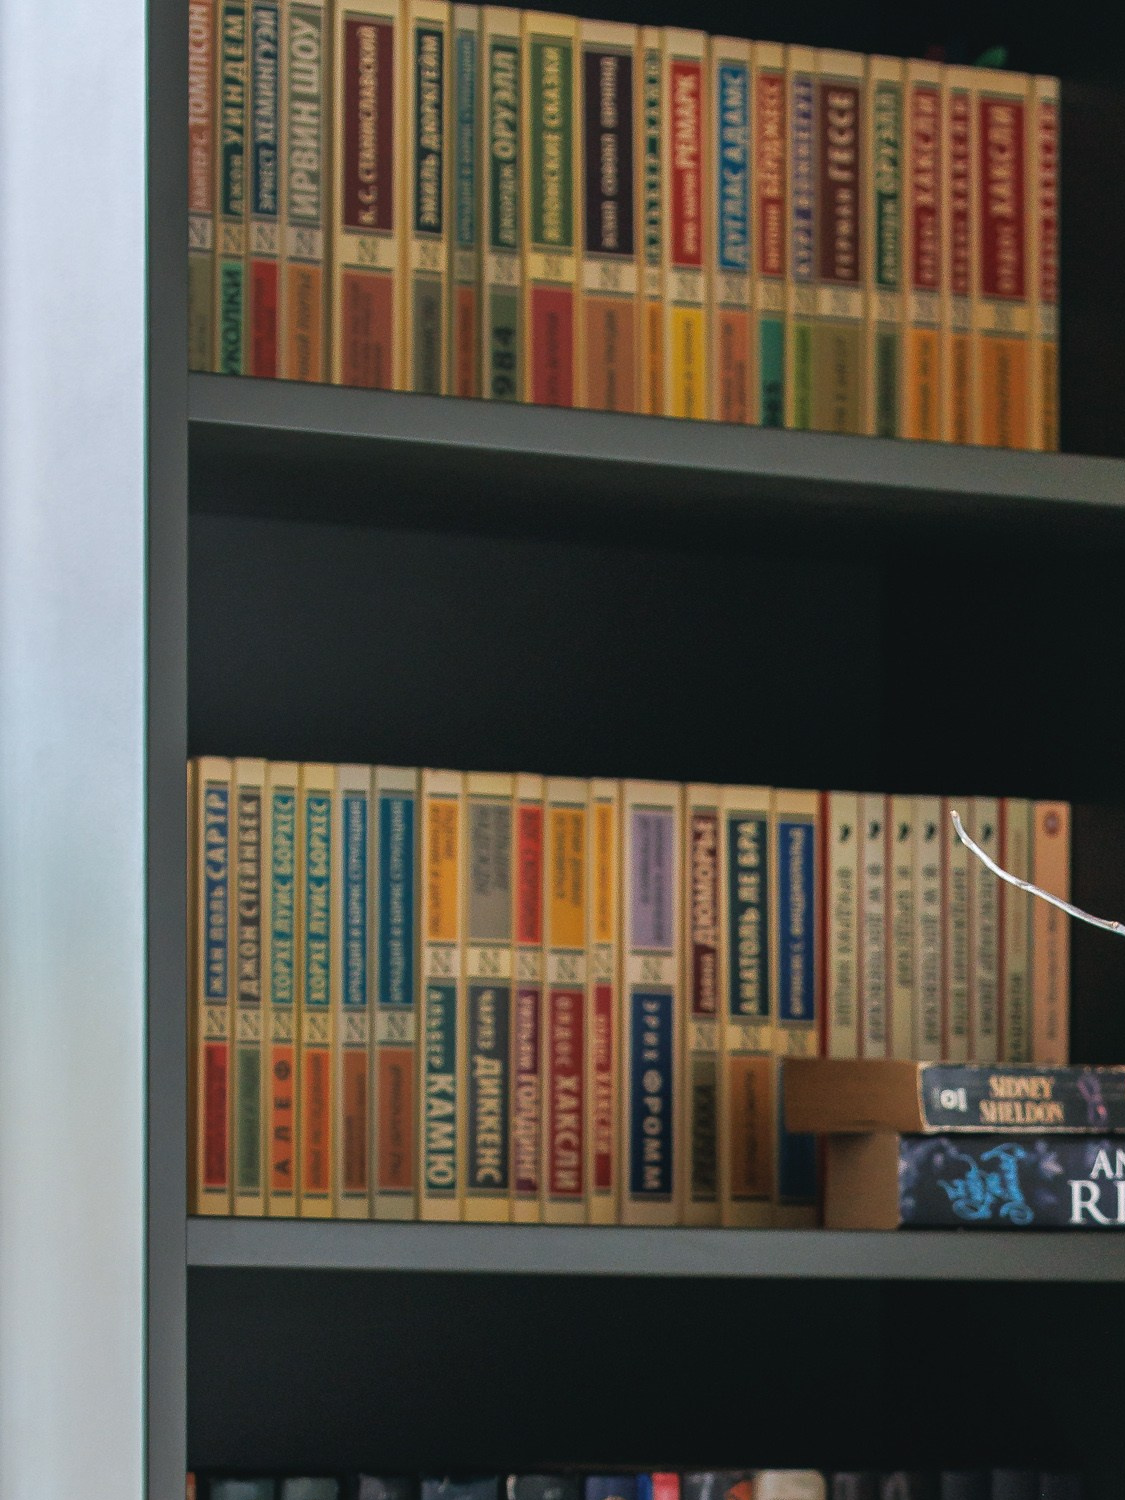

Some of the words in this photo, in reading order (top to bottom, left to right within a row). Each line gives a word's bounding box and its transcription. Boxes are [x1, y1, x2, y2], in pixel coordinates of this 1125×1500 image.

[187, 5, 207, 128] ТОМПСОН
[222, 14, 246, 145] УИНДЕМ
[252, 9, 275, 145] ХЕМИНГУЭЙ
[290, 16, 320, 95] ШОУ
[541, 45, 563, 128] СКАЗКИ
[355, 24, 379, 184] СТАНИСЛАВСКИЙ
[490, 50, 518, 161] ОРУЭЛЛ
[674, 73, 697, 170] РЕМАРК
[827, 90, 855, 183] ГЕССЕ
[288, 100, 320, 216] ИРВИН
[419, 153, 439, 227] ЭМИЛЬ
[222, 268, 244, 375] УКОЛКИ
[490, 326, 515, 396] 984
[205, 792, 226, 882] САРТР
[238, 800, 259, 918] СТЕЙНБЕК
[272, 799, 292, 876] БОРХЕС
[308, 801, 329, 877] БОРХЕС
[737, 822, 761, 868] БРА
[207, 885, 224, 941] ПОЛЬ
[272, 881, 292, 933] ЛУИС
[308, 882, 328, 935] ЛУИС
[691, 821, 719, 949] ДЮМОРЬЕ
[738, 873, 761, 904] ЛЕ
[209, 947, 224, 994] ЖАН
[239, 925, 259, 996] ДЖОН
[272, 939, 293, 1000] ХОРХЕ
[308, 941, 329, 1002] ХОРХЕ
[738, 907, 761, 1015] АНАТОЛЬ
[428, 989, 446, 1069] АЛЬБЕР
[641, 1000, 661, 1061] ЭРИХ
[273, 1061, 292, 1177] АЛЕФ
[426, 1072, 457, 1185] КАМЮ
[472, 1053, 503, 1183] ДИККЕНС
[641, 1068, 663, 1189] ФРОММ
[978, 1100, 1066, 1124] SHELDON
[989, 1075, 1056, 1100] SIDNEY
[553, 1073, 580, 1189] ХАКСЛИ
